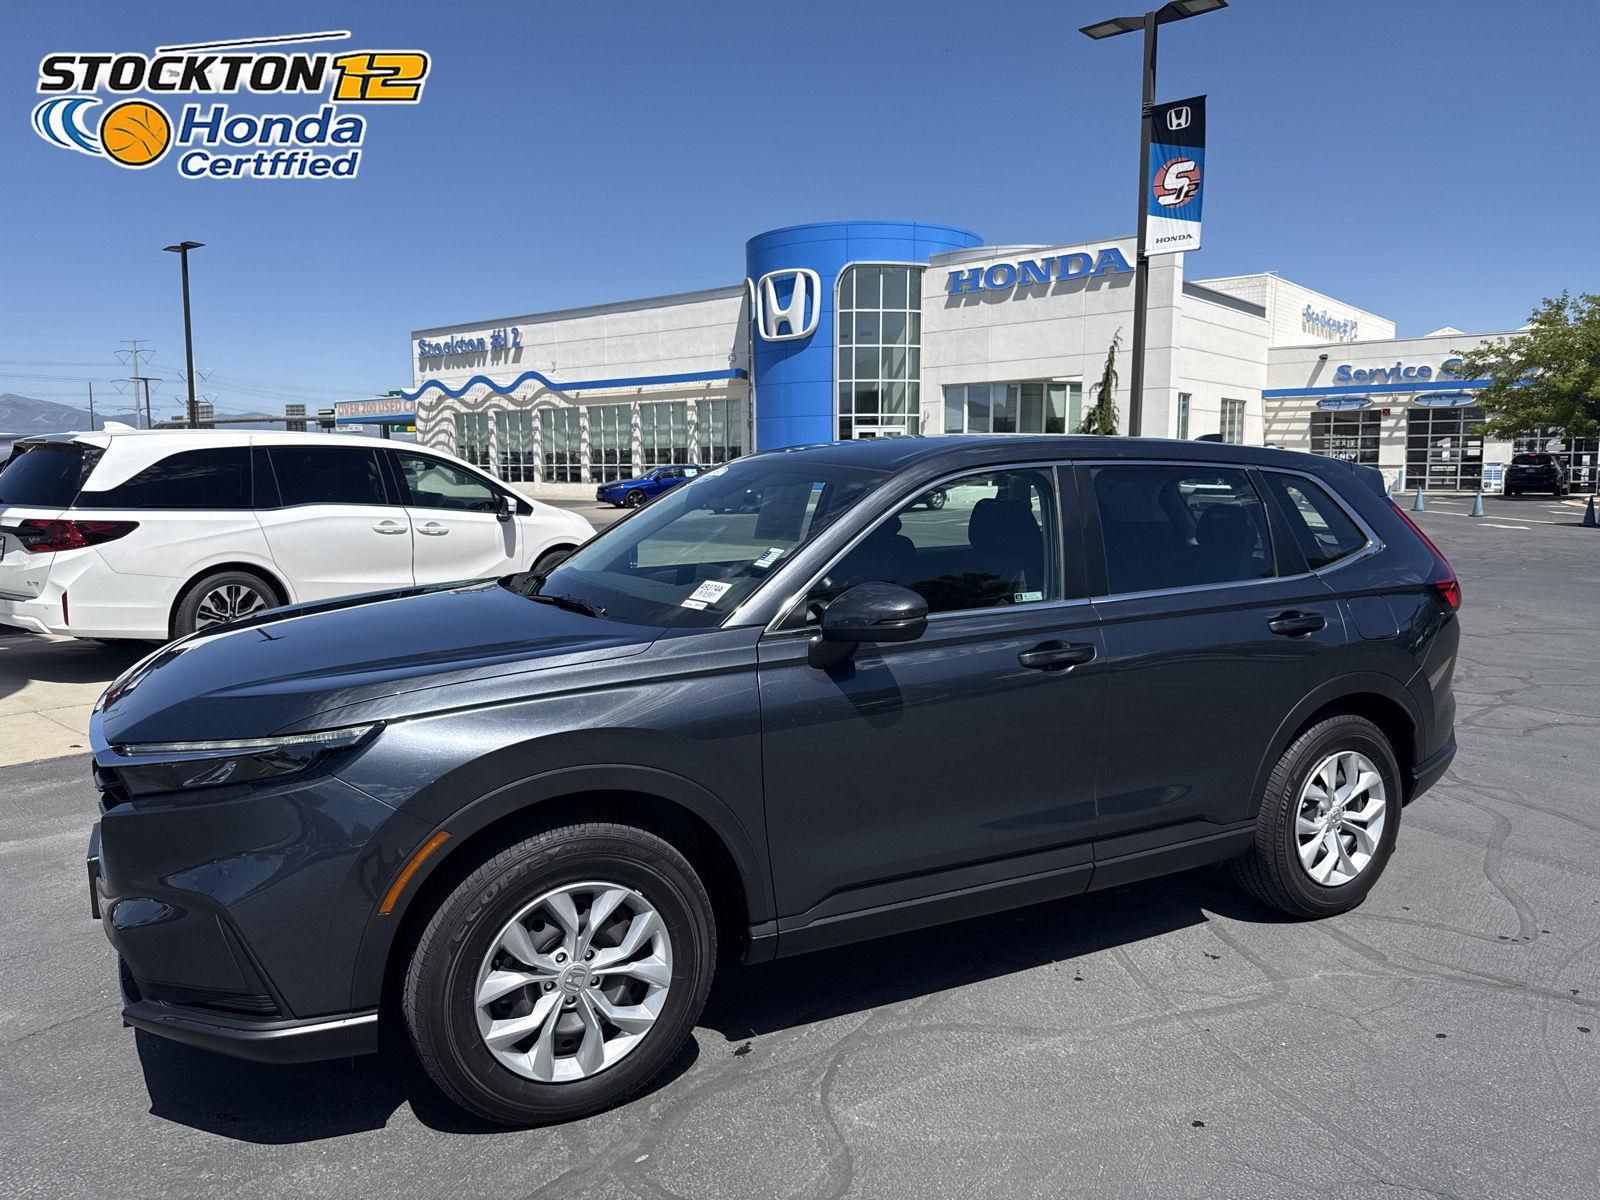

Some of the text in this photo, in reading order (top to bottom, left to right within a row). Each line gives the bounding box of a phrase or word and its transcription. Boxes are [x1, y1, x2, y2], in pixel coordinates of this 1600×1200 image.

[1155, 233, 1193, 244] HONDA
[947, 247, 1136, 296] HONDA
[417, 335, 486, 358] Stockton
[1335, 361, 1433, 383] Service
[338, 402, 360, 416] OVER
[378, 400, 401, 414] USED
